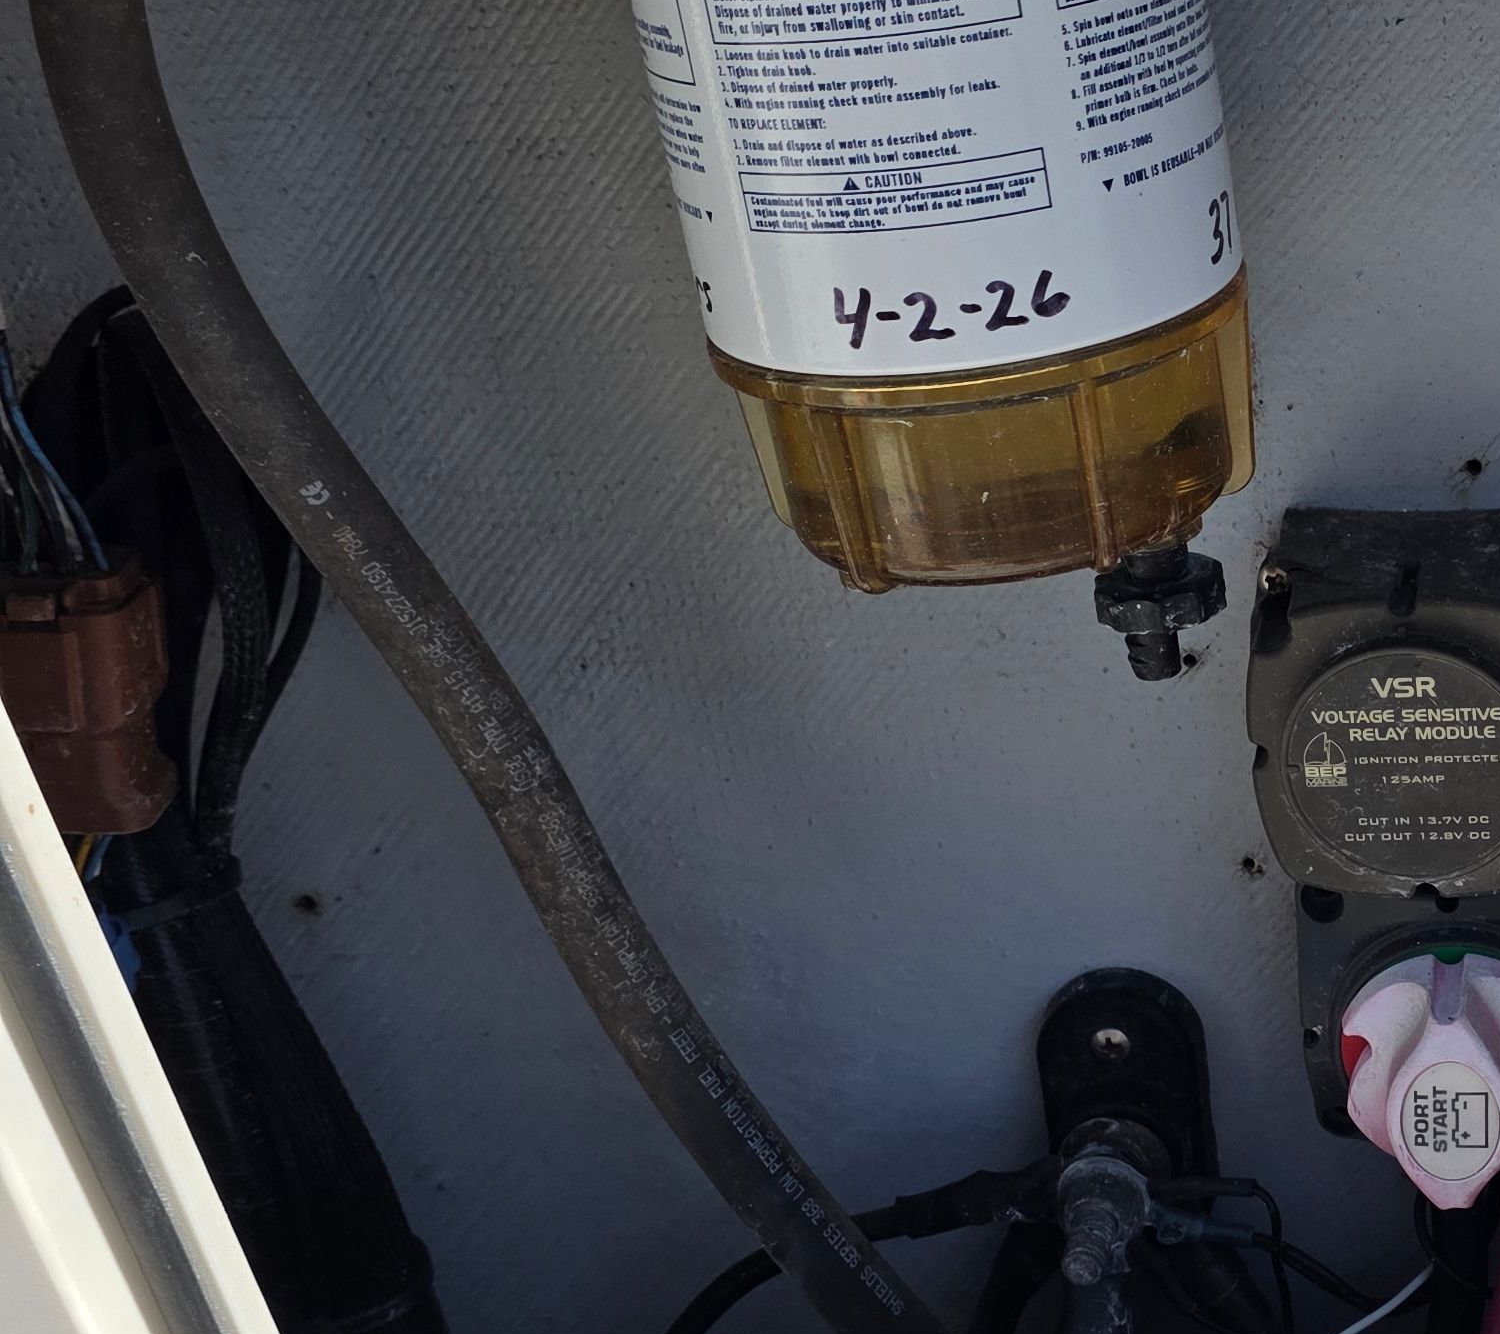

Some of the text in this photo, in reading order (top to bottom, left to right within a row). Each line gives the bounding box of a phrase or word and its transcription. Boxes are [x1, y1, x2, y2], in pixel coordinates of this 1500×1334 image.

[714, 4, 749, 20] Dispose
[752, 3, 762, 17] of
[765, 2, 803, 17] drained
[805, 3, 836, 15] water
[717, 4, 964, 36] fire, or injury from swallowing or skin contact.
[723, 48, 753, 61] Loosen
[756, 49, 780, 61] drain
[782, 48, 806, 60] knob
[808, 48, 821, 59] to
[823, 45, 850, 58] drain
[853, 44, 883, 56] water
[886, 41, 909, 53] into
[912, 34, 956, 50] suitable
[959, 27, 1012, 43] container.
[717, 64, 816, 79] 2. Tighten drain knob.
[730, 81, 763, 95] Dispose
[766, 81, 776, 93] of
[778, 80, 814, 93] drained
[817, 80, 846, 91] water
[850, 75, 897, 91] properly.
[733, 97, 753, 109] With
[755, 98, 785, 111] engine
[787, 97, 825, 110] running
[828, 94, 858, 107] check
[861, 92, 892, 105] entire
[896, 86, 946, 102] assembly
[948, 83, 964, 95] for
[968, 79, 1000, 92] leaks.
[727, 117, 826, 130] TO REPLACE ELEMENT:
[732, 127, 976, 153] 1. Drain and dispose of water as described above.
[735, 144, 961, 167] 2. Remove filter element with bowl connected.
[1080, 149, 1101, 163] P/N:
[864, 171, 922, 188] CAUTION
[1123, 163, 1159, 186] BOWL IS
[833, 270, 1070, 349] 4-2-26
[1371, 676, 1436, 698] VSR
[1311, 709, 1395, 724] VOLTAGE
[477, 715, 511, 754] TYPE
[1350, 726, 1496, 742] RELAY MODULE
[1305, 766, 1346, 777] BEP
[1354, 756, 1419, 765] IGNITION
[1306, 778, 1348, 786] MARINE
[1382, 775, 1445, 784] 125AMP
[1359, 816, 1489, 826] CUT IN 13.7V DC
[1345, 832, 1491, 842] CUT OUT 12.8V DC
[594, 909, 649, 984] COMPLIANT
[639, 981, 667, 1014] EPA
[669, 1026, 701, 1064] FEED
[695, 1063, 727, 1099] FUEL
[1414, 1091, 1429, 1146] PORT
[1433, 1086, 1447, 1152] START
[720, 1096, 785, 1174] PERMEATION
[778, 1171, 806, 1201] LOW
[799, 1197, 827, 1226] 368
[822, 1222, 864, 1268] SERIES
[859, 1264, 907, 1316] SHIELDS
